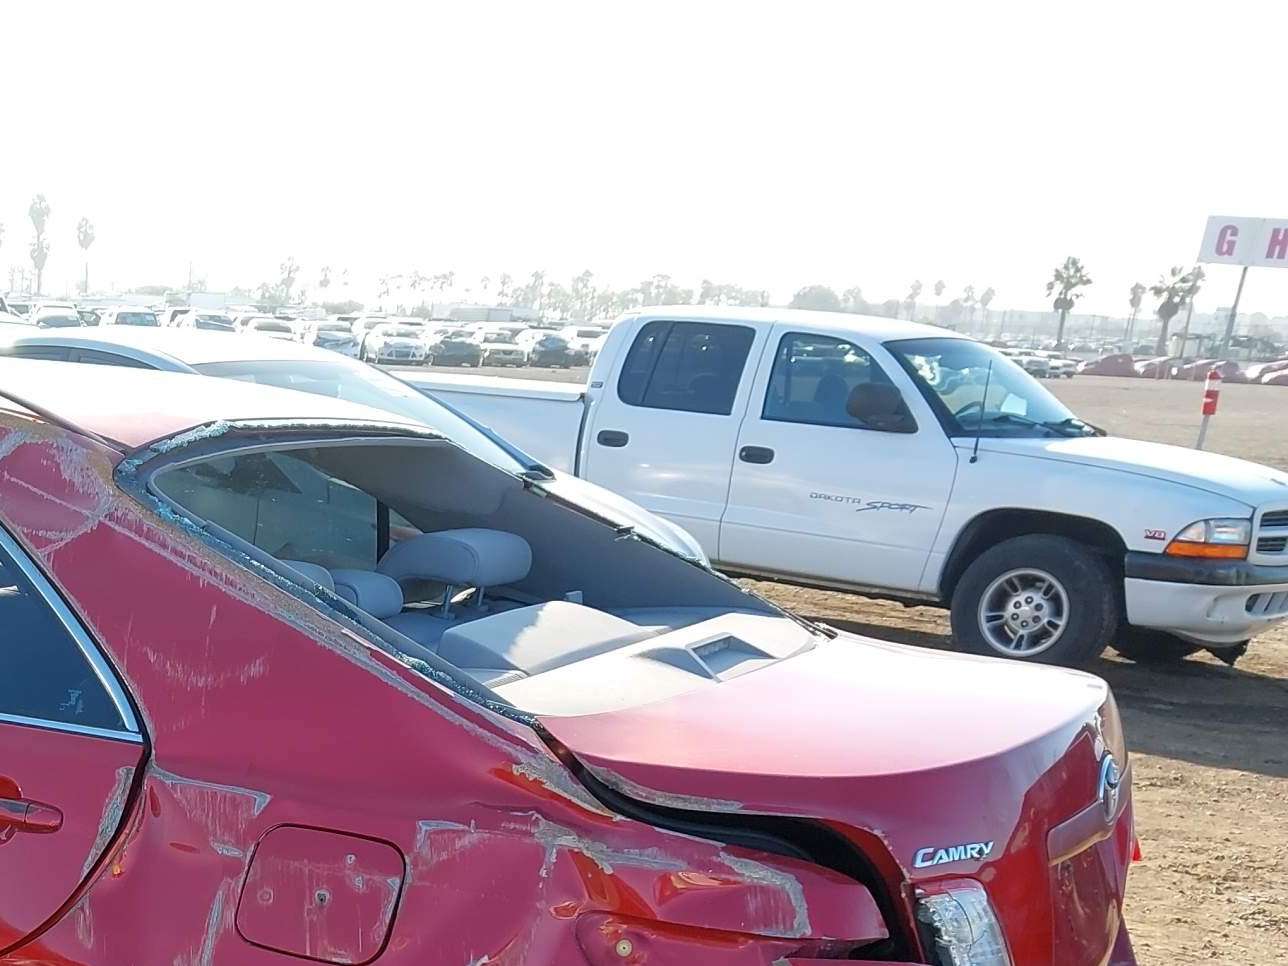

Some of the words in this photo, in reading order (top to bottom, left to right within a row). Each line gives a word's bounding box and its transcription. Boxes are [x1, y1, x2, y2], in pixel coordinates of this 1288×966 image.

[1215, 224, 1239, 257] G
[808, 490, 863, 505] DAKOTA
[855, 501, 934, 514] SPORT
[912, 840, 995, 869] CAMRY
